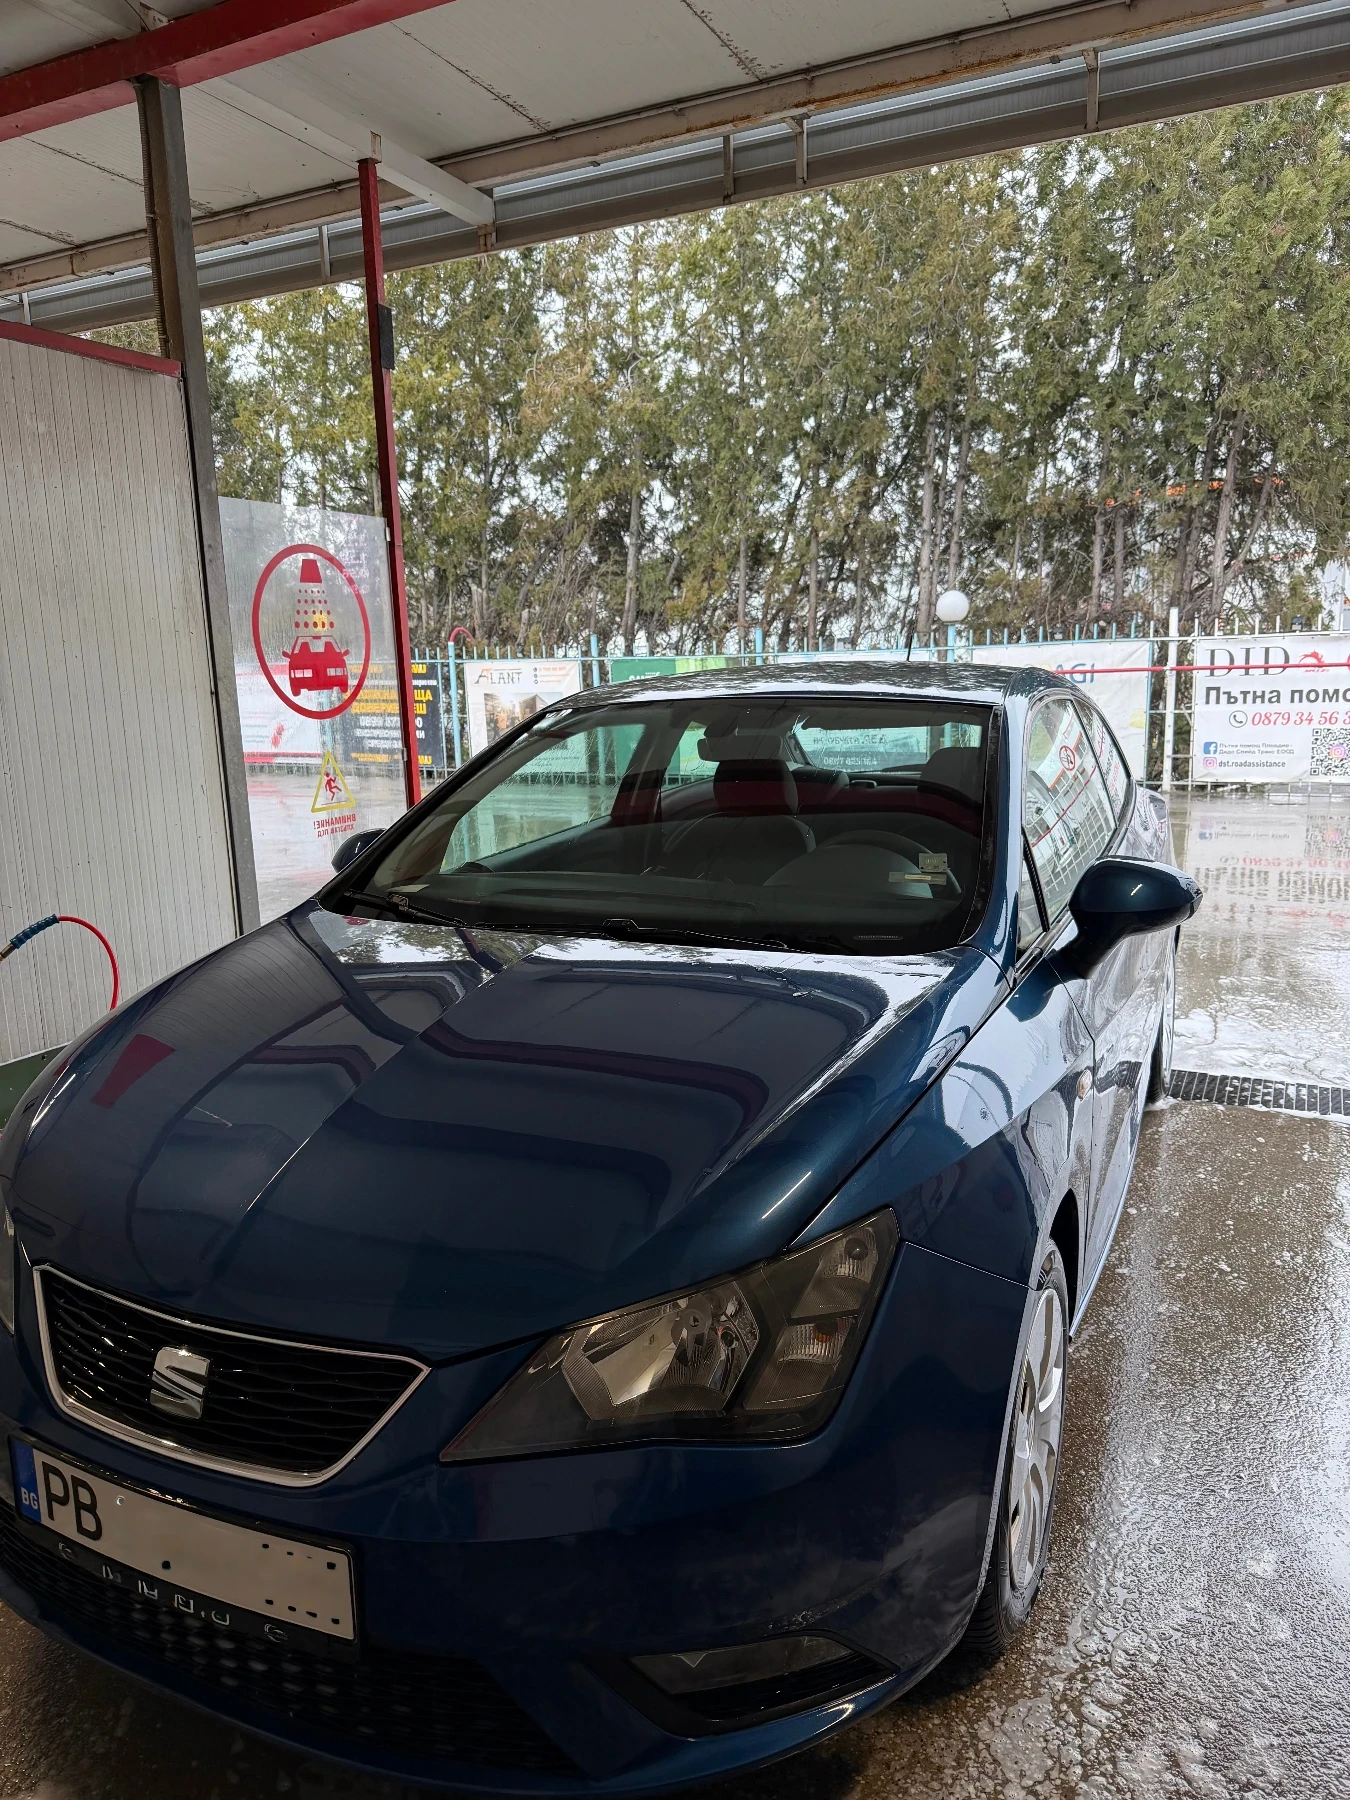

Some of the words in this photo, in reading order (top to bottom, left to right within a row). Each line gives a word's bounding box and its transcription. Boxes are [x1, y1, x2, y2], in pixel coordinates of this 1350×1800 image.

[1205, 646, 1290, 677] DID
[474, 668, 522, 684] ALANT
[1205, 686, 1281, 705] Пътна
[1290, 688, 1350, 704] помо
[1251, 711, 1291, 726] 0879
[1294, 711, 1314, 725] 34
[1318, 711, 1339, 725] 56
[21, 1487, 39, 1510] BG
[42, 1461, 103, 1541] PB
